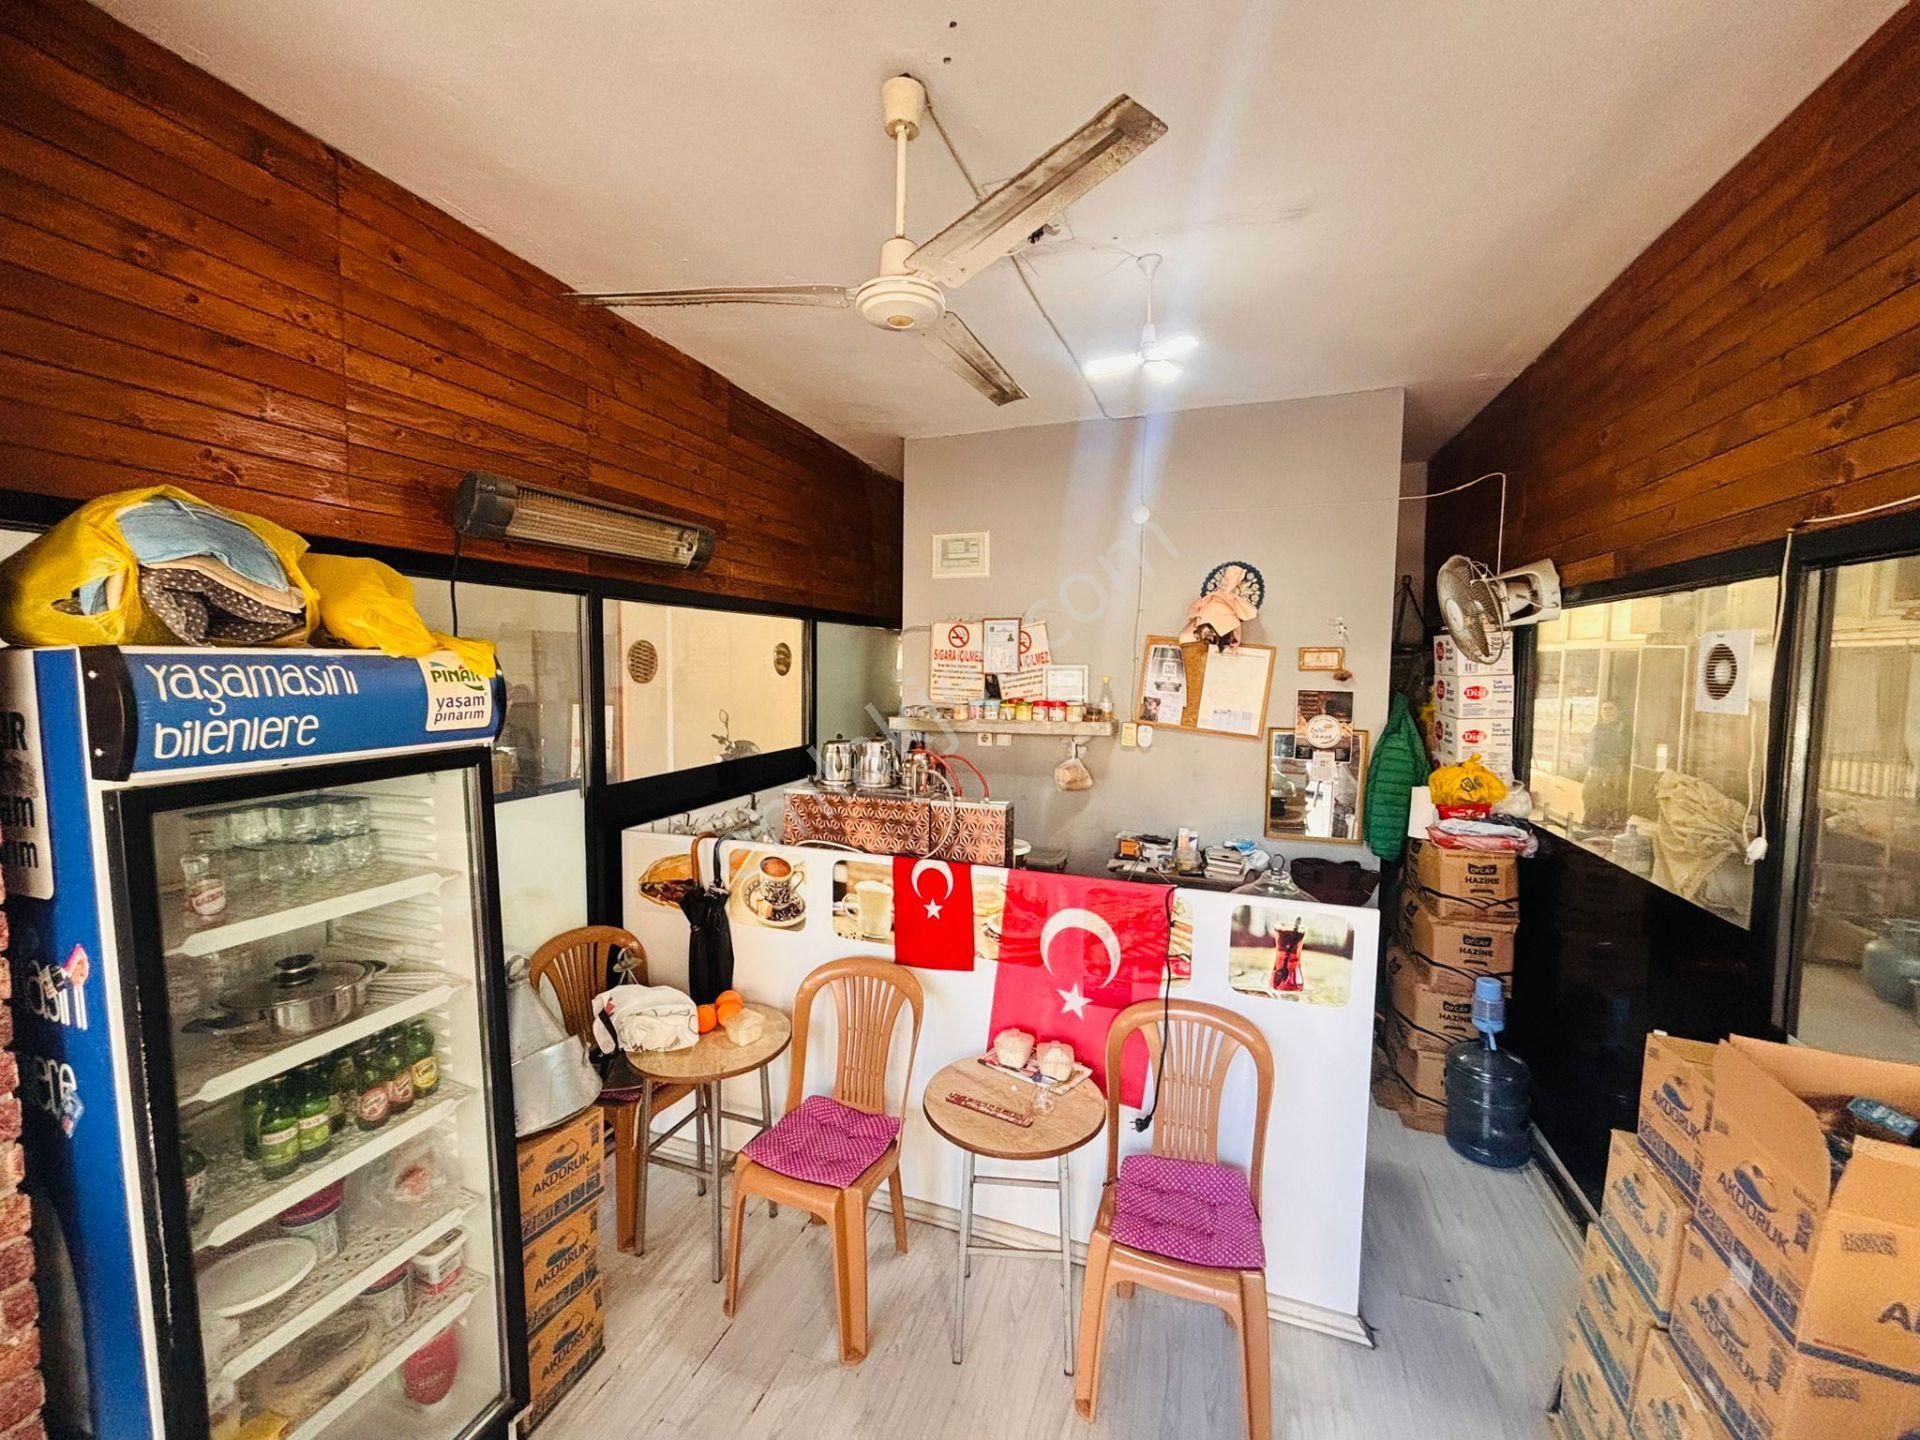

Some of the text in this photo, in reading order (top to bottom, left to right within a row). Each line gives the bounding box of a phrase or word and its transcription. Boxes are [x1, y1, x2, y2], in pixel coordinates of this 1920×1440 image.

[434, 709, 484, 725] pınarım
[436, 695, 485, 712] yaşam
[533, 1152, 590, 1197] AKDORUK
[1717, 1171, 1790, 1259] AKDORUK
[534, 1239, 590, 1293] AKDORUK
[542, 1317, 595, 1381] AKDORUK
